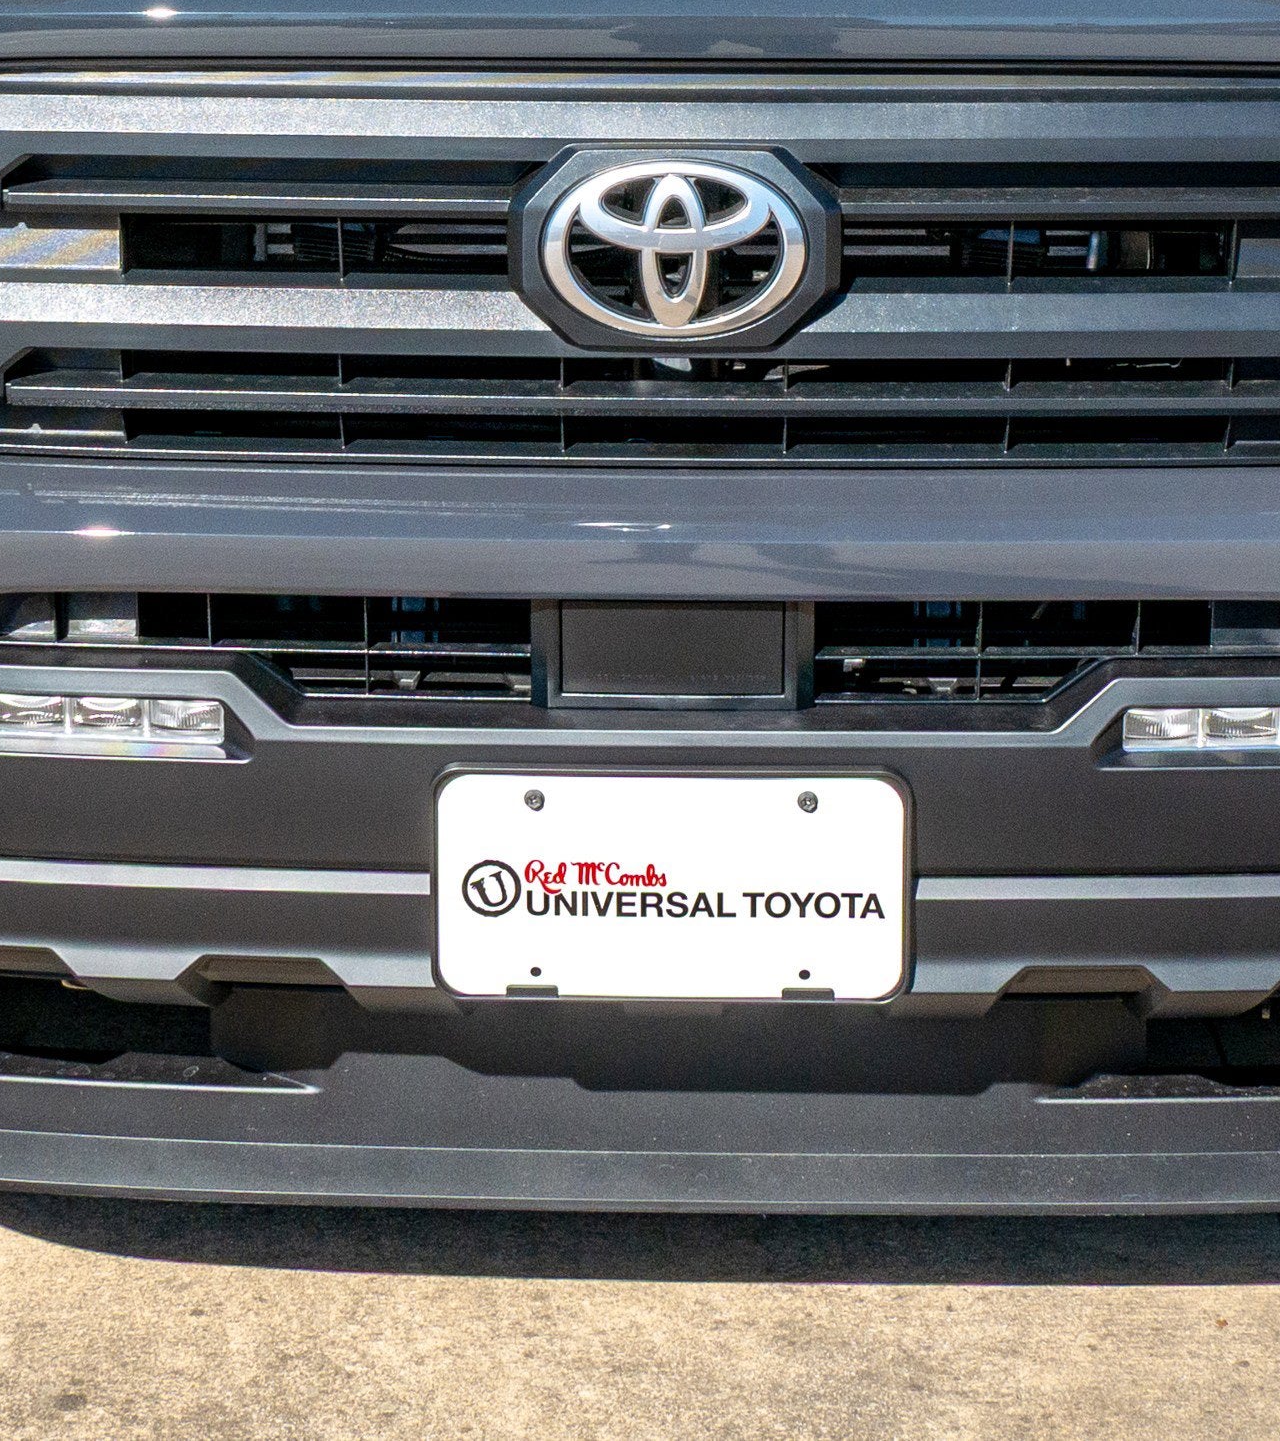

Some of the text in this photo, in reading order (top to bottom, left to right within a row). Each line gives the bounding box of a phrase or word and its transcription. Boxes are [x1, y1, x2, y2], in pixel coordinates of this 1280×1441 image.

[524, 859, 668, 894] Red McCombs
[526, 890, 886, 919] UNIVERSAL TOYOTA
